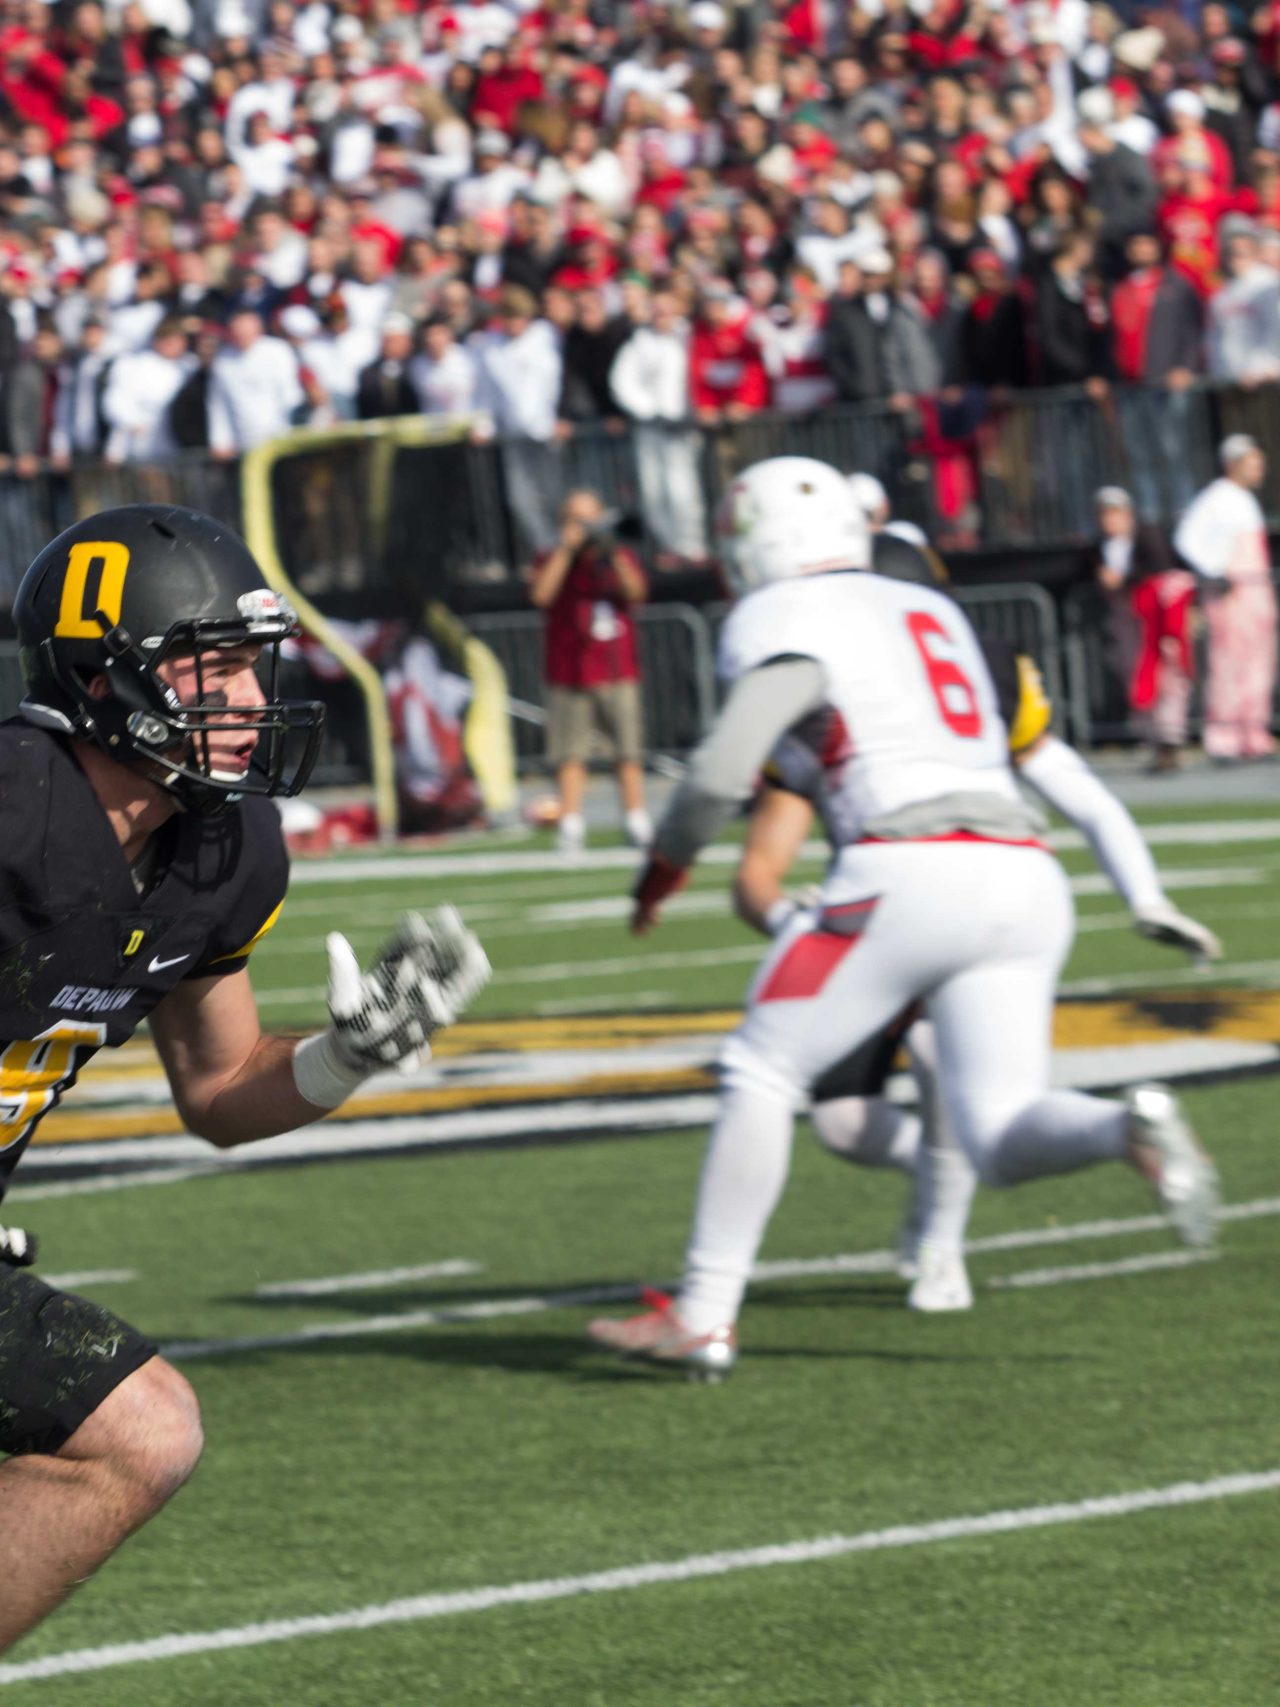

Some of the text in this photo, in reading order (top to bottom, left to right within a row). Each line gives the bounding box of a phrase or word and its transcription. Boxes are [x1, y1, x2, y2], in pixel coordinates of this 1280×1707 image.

[905, 610, 983, 739] 6
[123, 929, 145, 956] D
[49, 984, 140, 1013] DEPAUW
